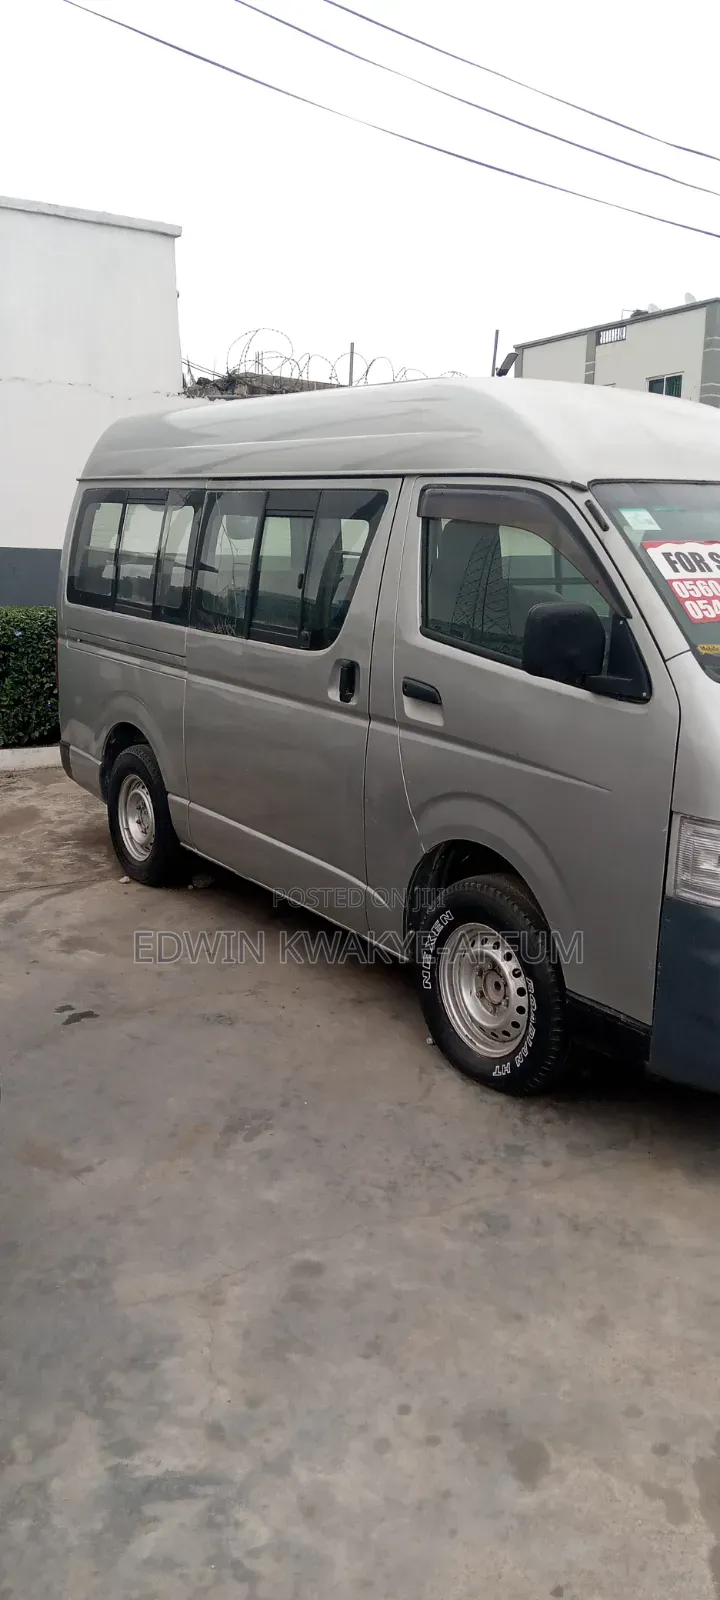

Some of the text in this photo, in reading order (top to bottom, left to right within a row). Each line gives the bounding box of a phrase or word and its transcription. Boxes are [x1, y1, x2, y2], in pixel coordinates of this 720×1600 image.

[661, 552, 713, 573] FOR
[422, 910, 454, 989] NEXEN
[492, 1062, 511, 1076] HT
